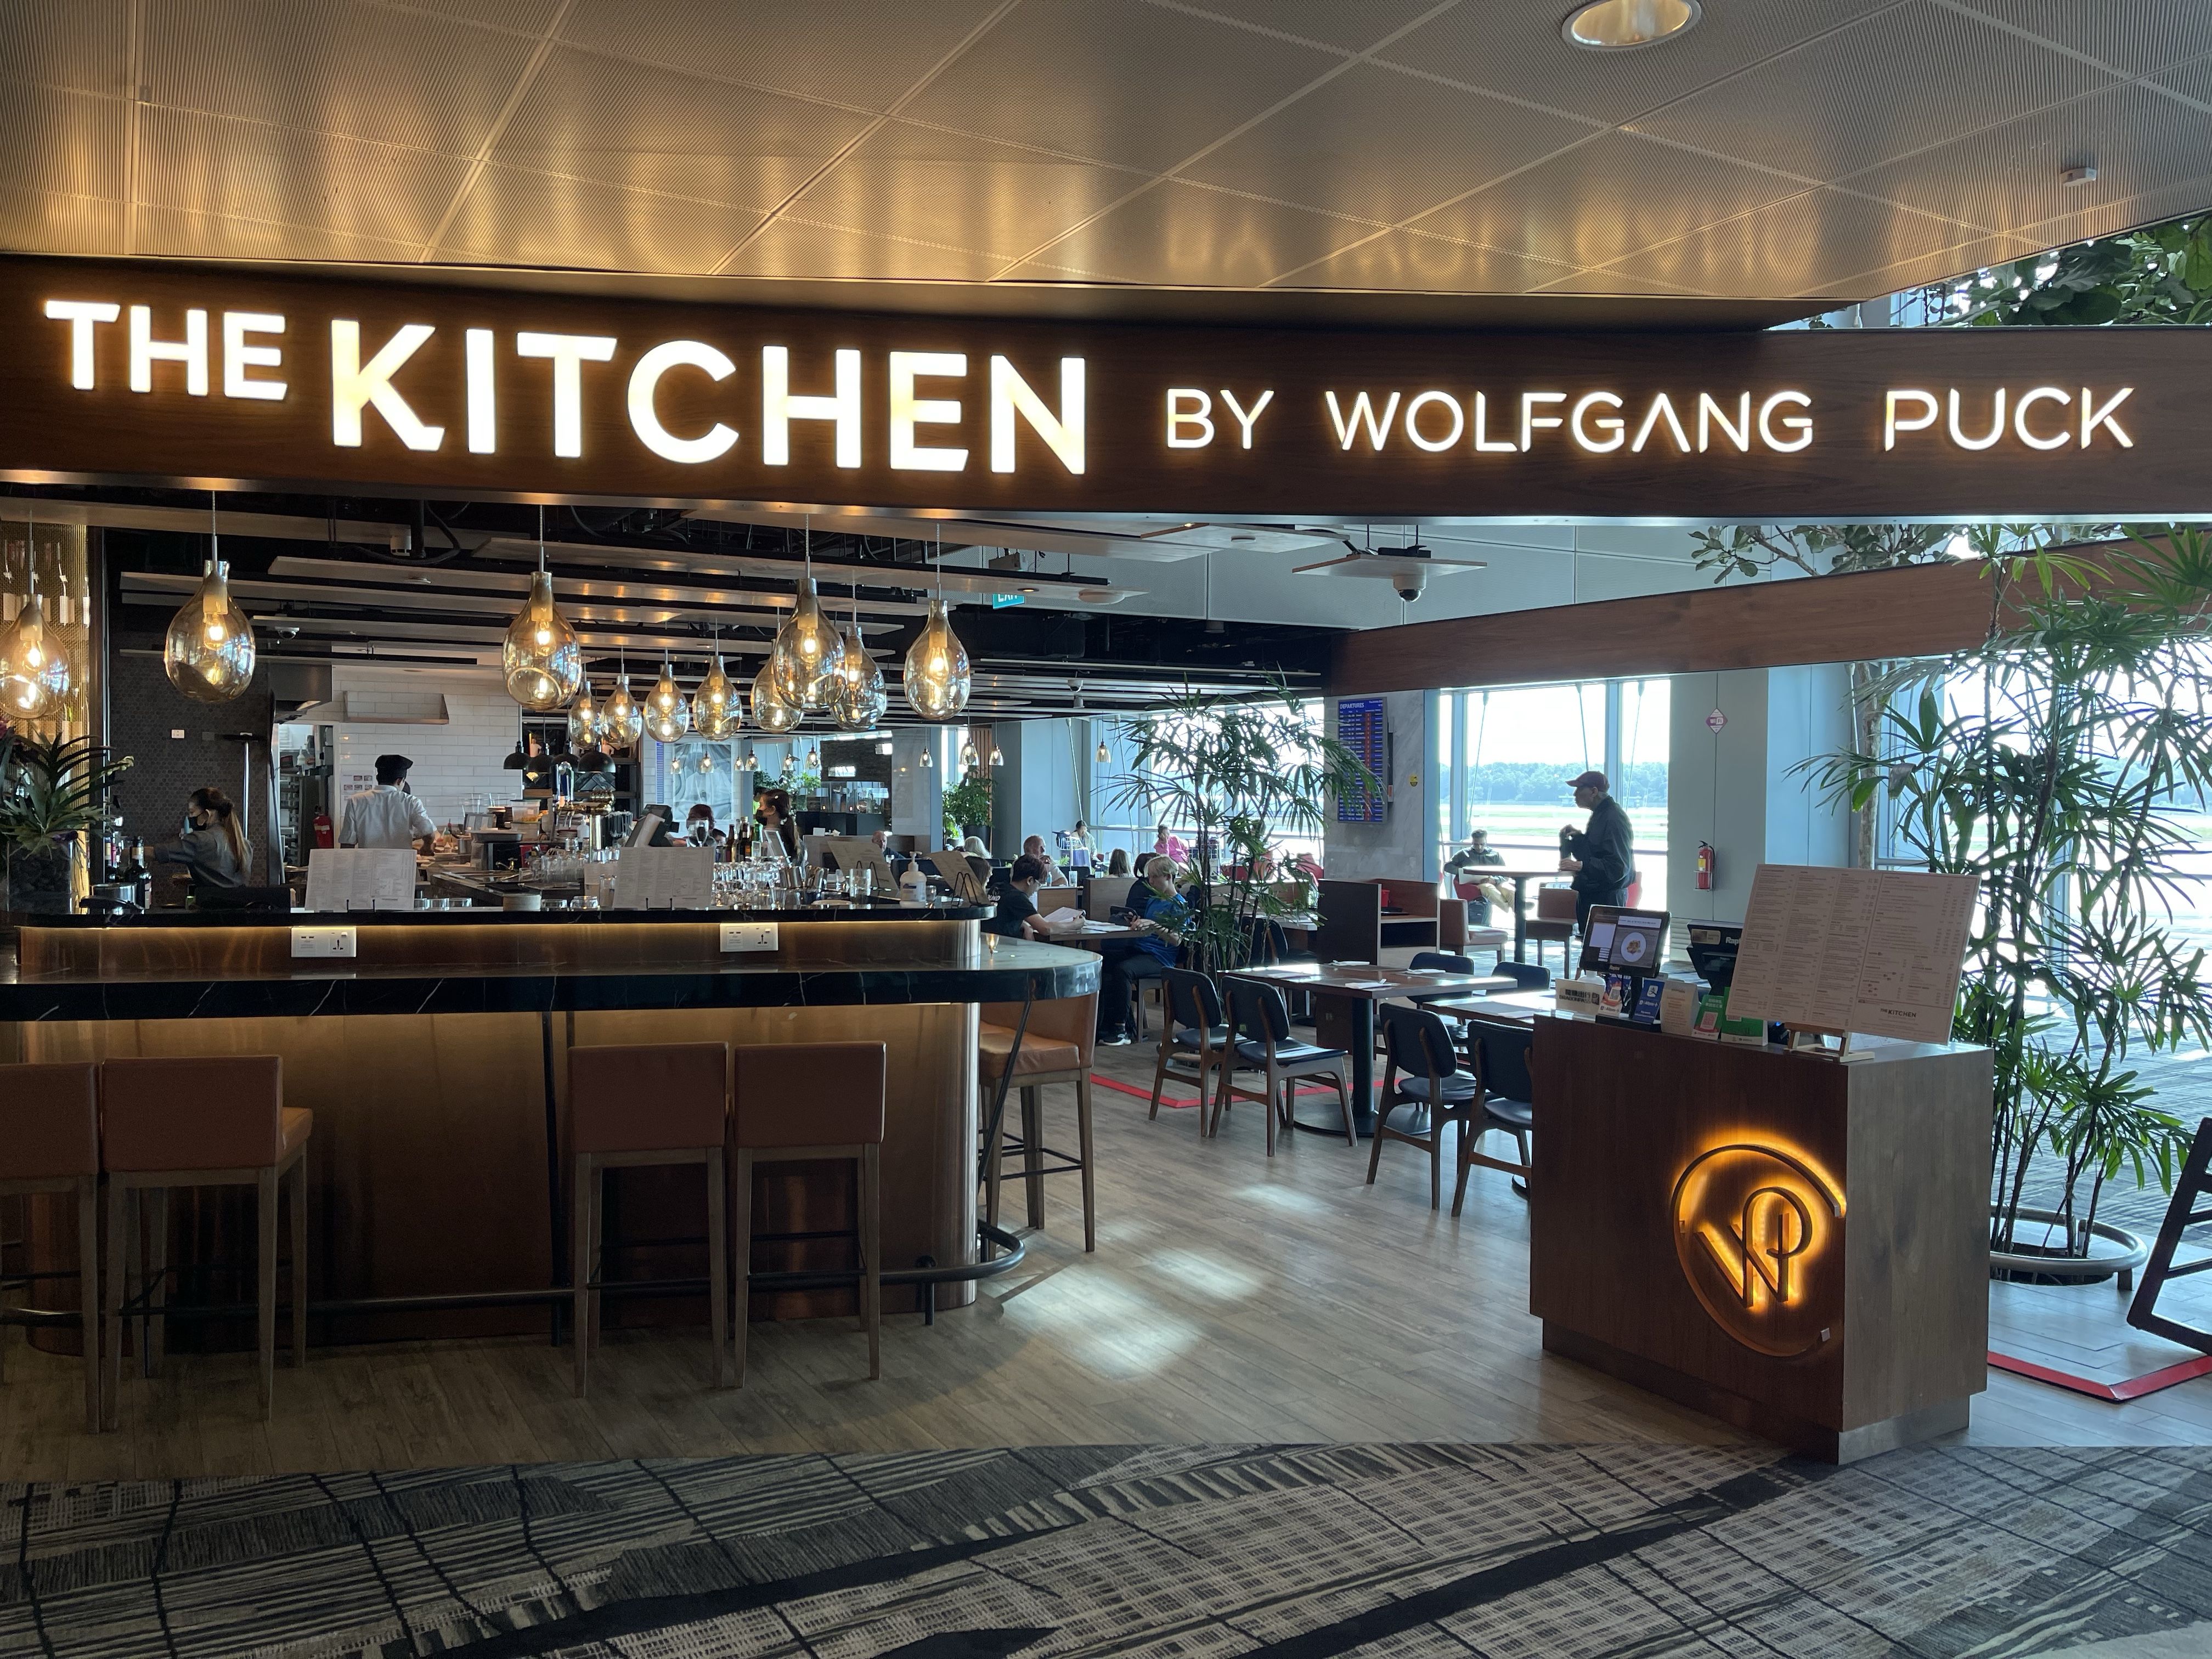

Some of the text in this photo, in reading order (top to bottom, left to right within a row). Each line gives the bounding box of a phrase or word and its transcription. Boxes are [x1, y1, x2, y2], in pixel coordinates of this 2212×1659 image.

[44, 300, 2135, 475] THE KITCHEN BY WOLFGANG PUCK
[1888, 1009, 1917, 1018] KITCHEN
